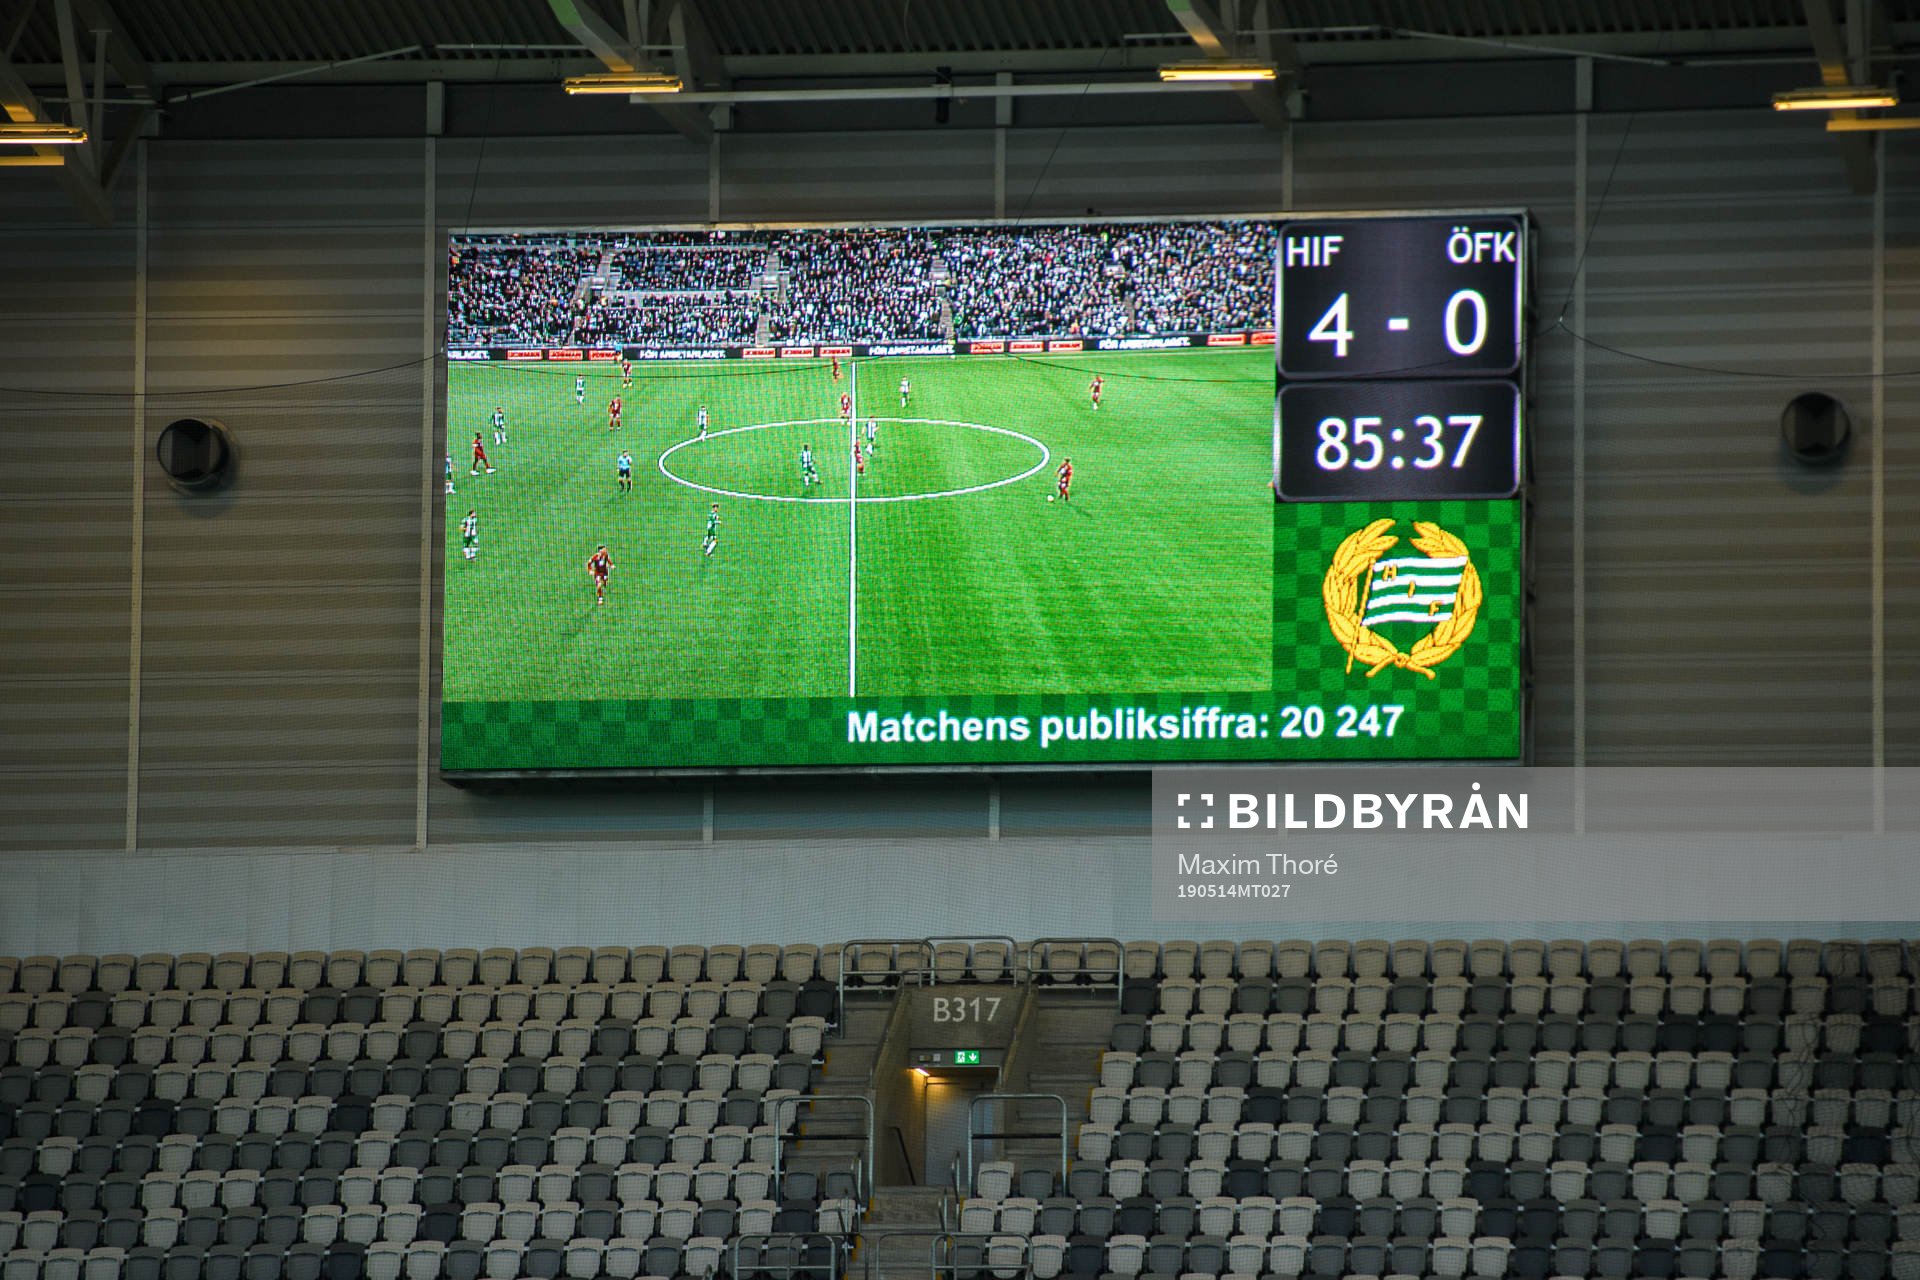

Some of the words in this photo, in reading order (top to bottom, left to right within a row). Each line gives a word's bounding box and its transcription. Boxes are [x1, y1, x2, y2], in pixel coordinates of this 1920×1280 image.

[1286, 236, 1344, 267] HIF
[1447, 226, 1516, 263] ÖFK
[1308, 292, 1354, 358] 4
[1388, 317, 1410, 331] -
[1445, 289, 1489, 355] 0
[1315, 415, 1483, 471] 85:37
[847, 710, 1030, 742] Matchens
[1041, 706, 1269, 748] publiksiffra:
[1280, 705, 1325, 738] 20
[1335, 704, 1405, 737] 247
[933, 997, 1001, 1022] B317
